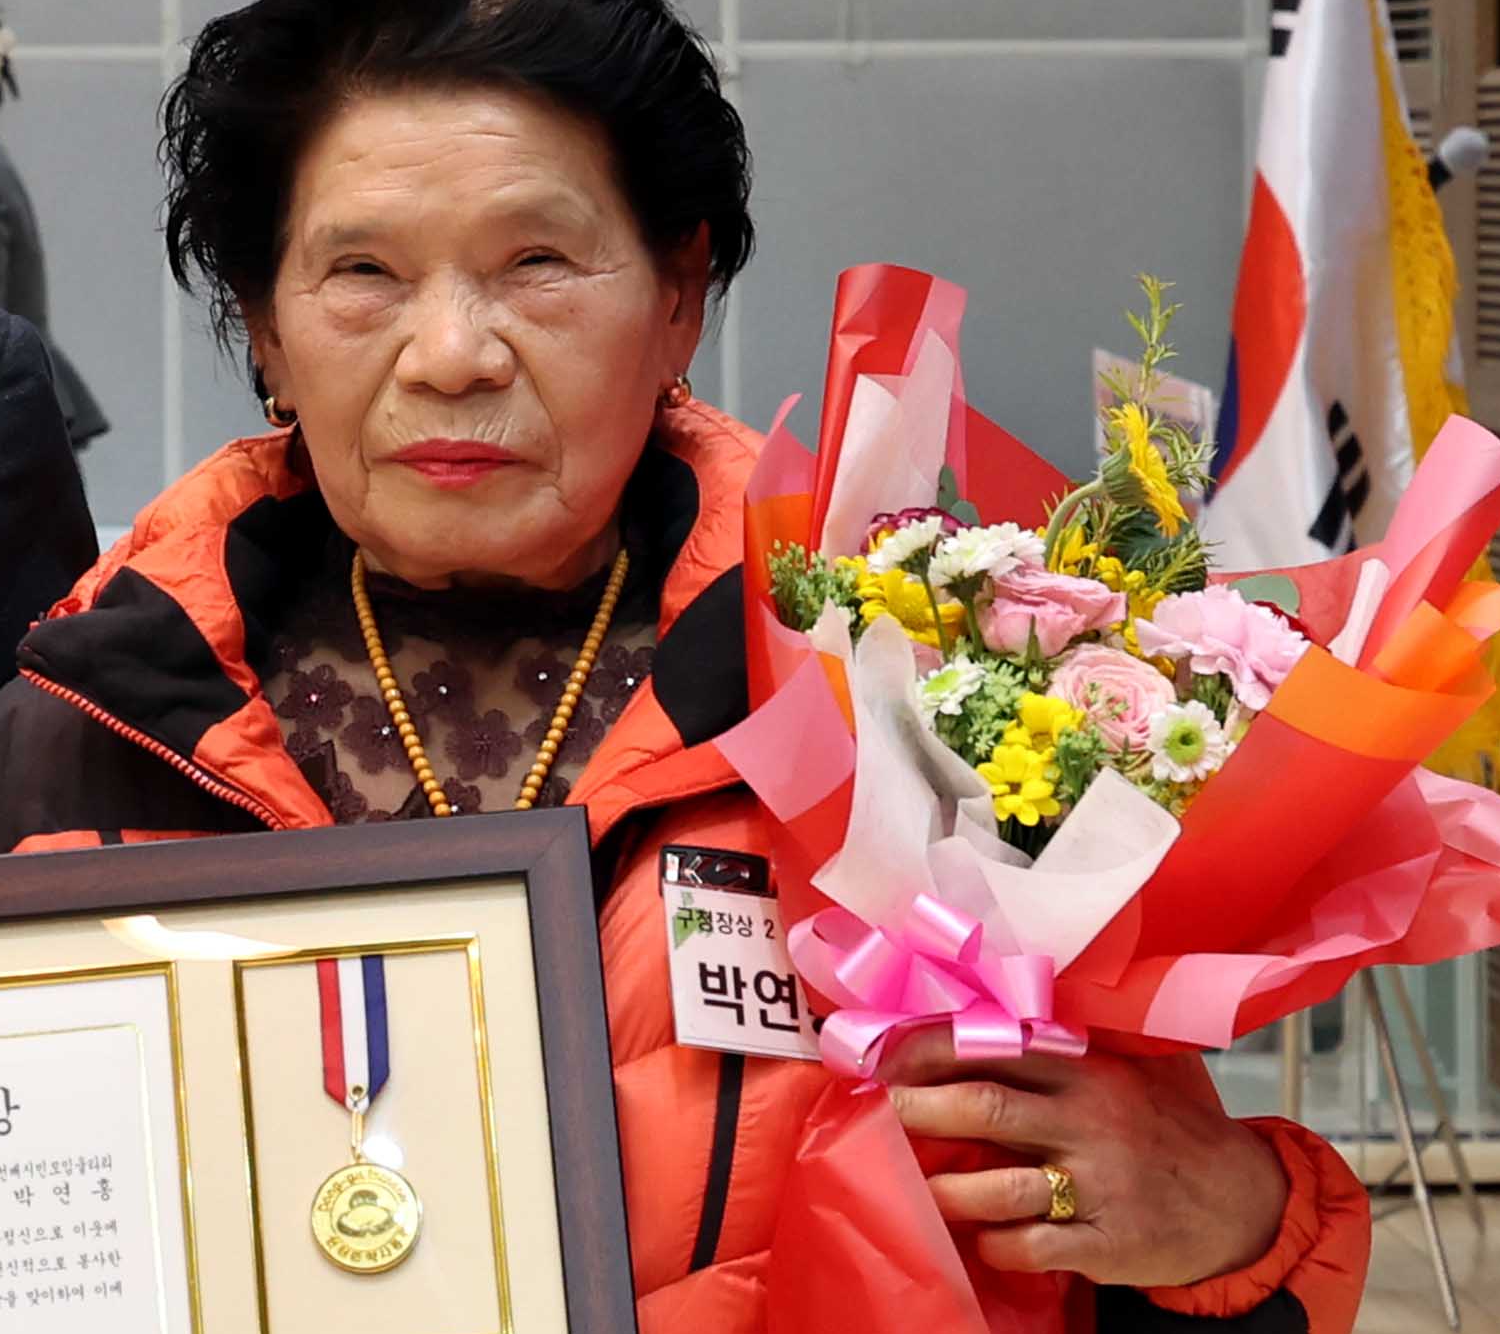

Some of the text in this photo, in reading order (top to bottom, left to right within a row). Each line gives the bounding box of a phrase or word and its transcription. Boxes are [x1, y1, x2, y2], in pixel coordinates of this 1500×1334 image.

[763, 918, 777, 941] 2
[697, 961, 823, 1036] 박연
[77, 1249, 122, 1270] 봉사한
[93, 1280, 123, 1299] 이에
